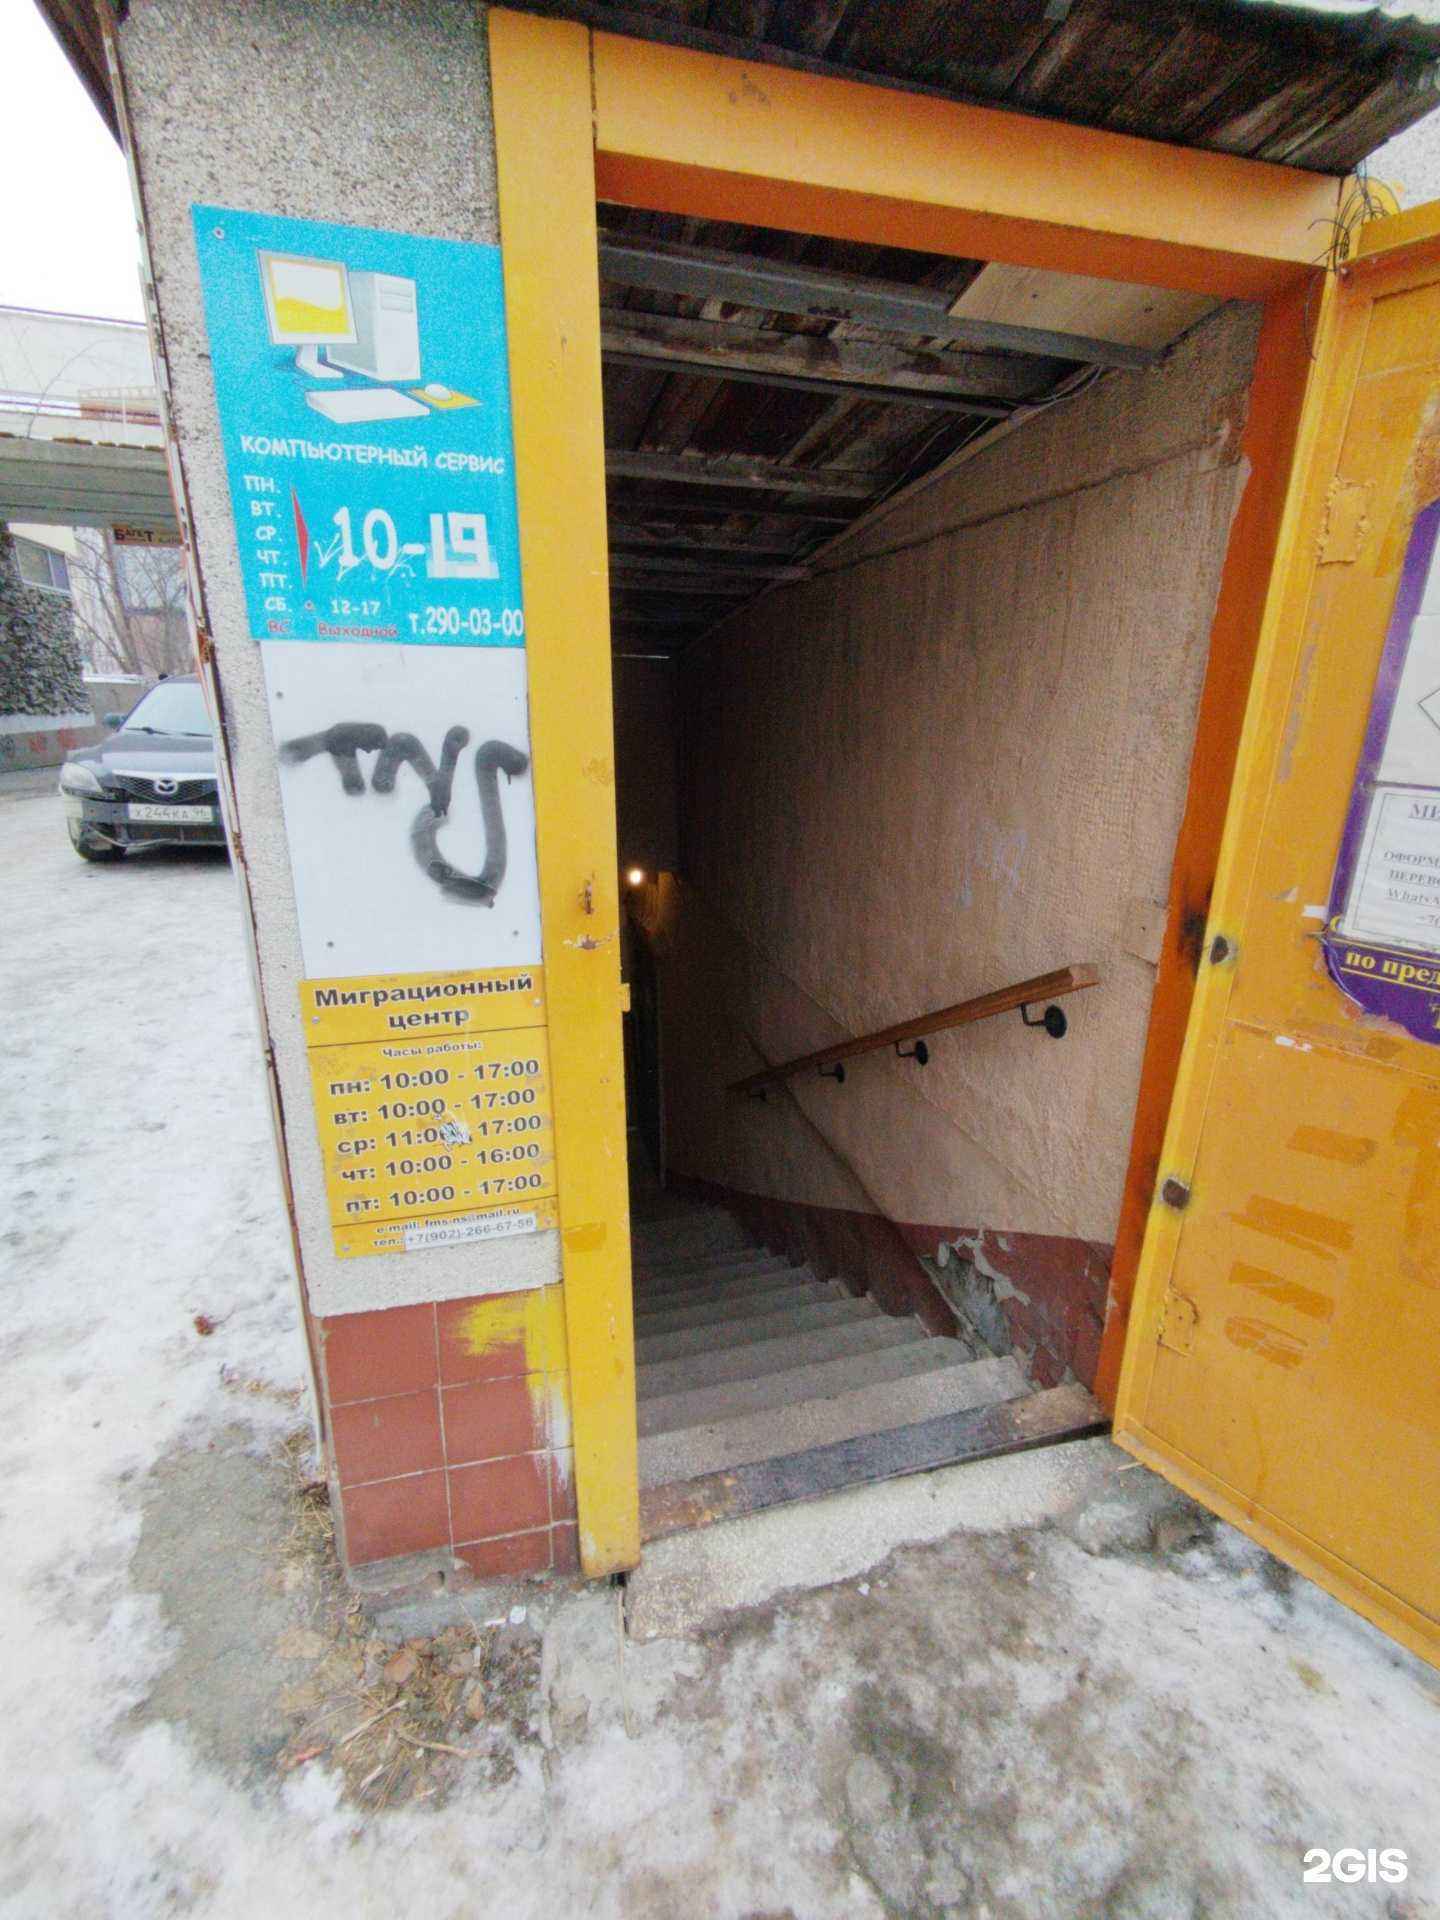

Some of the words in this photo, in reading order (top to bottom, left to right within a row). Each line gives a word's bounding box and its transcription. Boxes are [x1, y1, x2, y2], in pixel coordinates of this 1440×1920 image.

[241, 436, 427, 468] КОМПЬЮТЕРНЫЙ
[435, 452, 505, 475] СЕРВИС
[243, 475, 281, 493] ПН.
[251, 501, 282, 518] ВТ.
[255, 526, 283, 542] СР.
[257, 549, 287, 566] ЧТ.
[259, 573, 293, 589] ПТ.
[1345, 952, 1376, 970] по
[315, 974, 532, 1007] Миграционный
[389, 1009, 470, 1030] центр
[383, 1047, 422, 1059] Часы
[426, 1041, 481, 1055] работы:
[330, 1079, 370, 1095] пн:
[380, 1068, 449, 1091] 10:00
[474, 1059, 539, 1080] 17:00
[334, 1110, 367, 1125] вт:
[377, 1098, 445, 1120] 10:00
[471, 1088, 535, 1110] 17:00
[337, 1138, 376, 1155] ср:
[478, 1115, 541, 1137] 17:00
[342, 1167, 376, 1181] чт:
[385, 1155, 451, 1177] 10:00
[476, 1143, 540, 1165] 16:00
[346, 1199, 379, 1213] пт:
[390, 1186, 455, 1207] 10:00
[480, 1173, 542, 1195] 17:00
